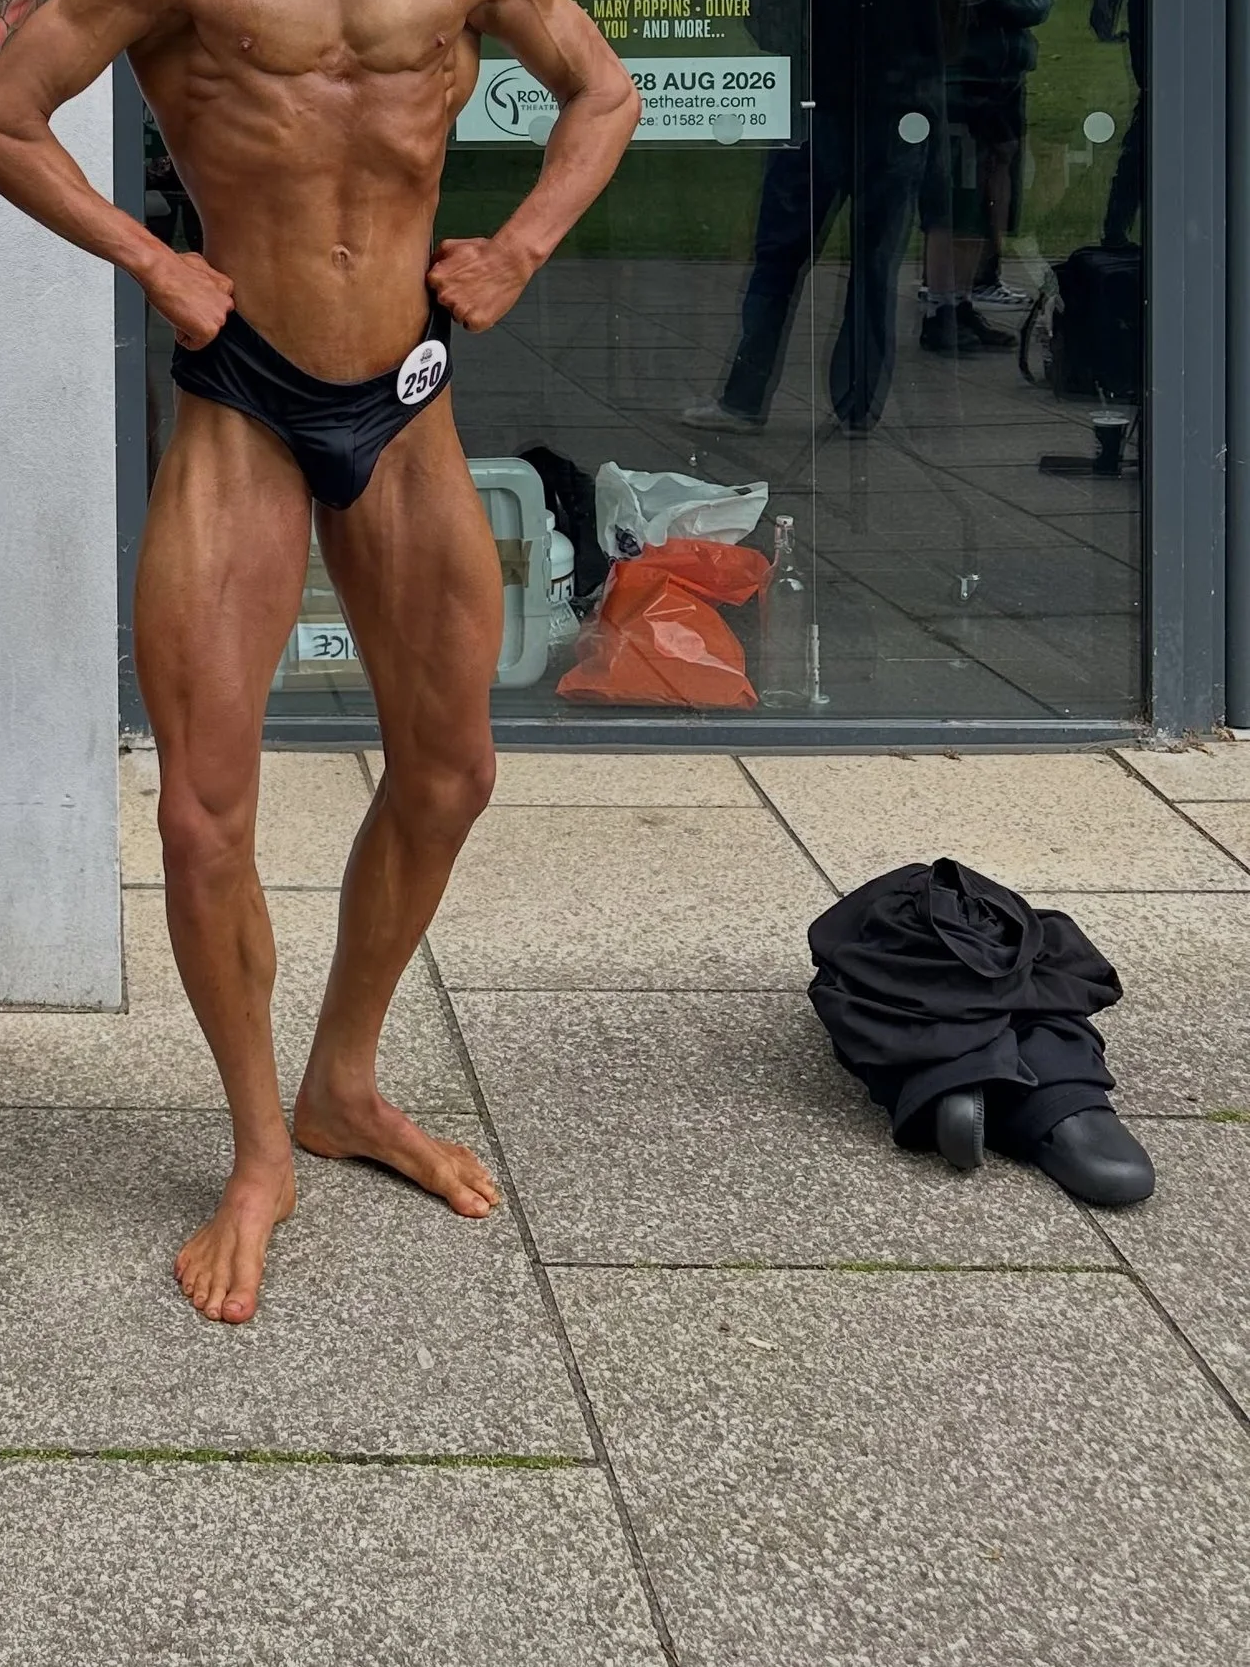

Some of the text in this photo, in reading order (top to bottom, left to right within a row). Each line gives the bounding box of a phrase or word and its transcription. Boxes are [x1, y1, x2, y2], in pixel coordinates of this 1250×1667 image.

[593, 0, 630, 18] MARY
[603, 19, 725, 39] YOU AND MORE...
[631, 71, 776, 91] 28 AUG 2026
[663, 113, 704, 126] 01582
[750, 113, 767, 126] 80
[402, 361, 442, 401] 250
